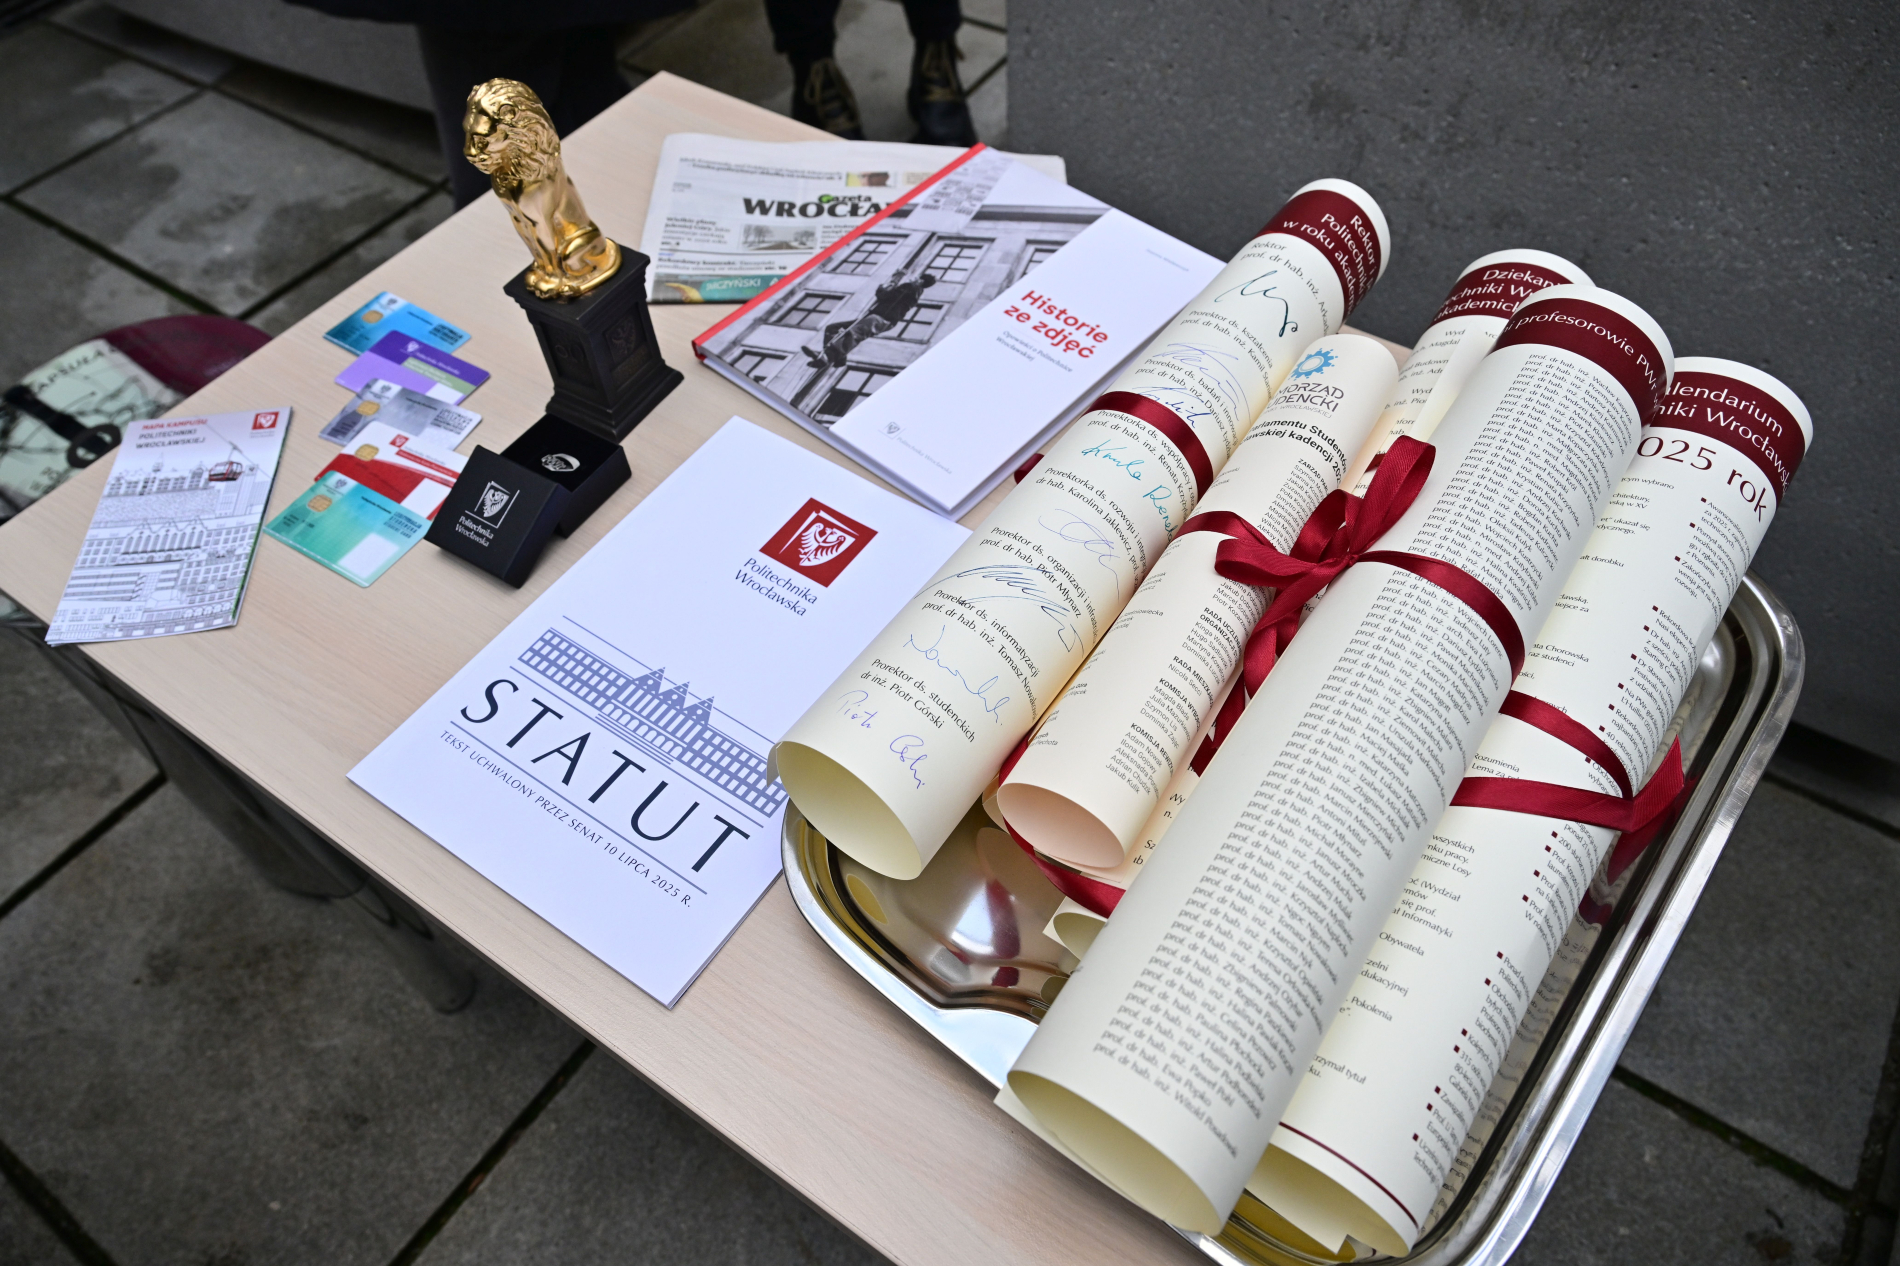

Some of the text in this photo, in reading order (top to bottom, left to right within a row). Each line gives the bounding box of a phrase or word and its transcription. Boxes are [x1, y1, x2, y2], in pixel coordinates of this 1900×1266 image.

[742, 197, 894, 218] WROCŁA
[817, 193, 872, 204] Gazeta
[1252, 241, 1287, 252] Rektor
[1283, 220, 1336, 250] w roku
[1350, 214, 1375, 265] Rektor
[1241, 251, 1265, 261] prof.
[1268, 252, 1283, 263] dr
[1283, 257, 1305, 280] hab.
[1305, 278, 1319, 300] inż.
[1482, 269, 1562, 288] Dziekan
[1021, 290, 1109, 343] Historie
[1003, 305, 1096, 359] ze zdjęć
[1180, 317, 1263, 372] prof. dr hab. inż. Kamil
[1228, 317, 1240, 329] ds.
[1241, 326, 1274, 369] kształcenia
[1515, 310, 1658, 392] profesorowie PWr
[1529, 352, 1548, 361] prof.
[1559, 359, 1577, 371] hab.
[1184, 368, 1197, 381] ds.
[1197, 377, 1222, 403] badań
[1665, 381, 1784, 438] lendarium
[138, 428, 198, 440] POLITECHNIKI
[166, 418, 208, 429] KAMPUSU
[135, 437, 206, 449] WROCŁAWSKIEJ
[1087, 420, 1179, 485] prof. dr hab. inż. Renata
[1288, 430, 1333, 464] kadencji
[1147, 429, 1159, 441] ds.
[1160, 440, 1192, 486] współpracy
[1035, 475, 1047, 486] dr
[1047, 477, 1066, 492] hab.
[1068, 486, 1104, 515] Karolina
[1641, 478, 1675, 490] wybrano
[1726, 468, 1768, 523] rok
[1095, 488, 1107, 502] ds.
[1108, 500, 1136, 535] rozwoju
[455, 523, 490, 548] Wrocławska
[458, 515, 494, 540] Politechnika
[1032, 544, 1044, 557] ds.
[1047, 554, 1088, 599] organizacji
[1591, 555, 1625, 568] dorobku
[742, 556, 818, 606] Politechnika
[979, 538, 1083, 619] prof. dr hab. Piotr Młynarz
[734, 568, 808, 618] Wrocławska
[1204, 607, 1223, 625] RADA
[1387, 577, 1407, 587] prof.
[1409, 583, 1421, 591] dr
[1421, 586, 1439, 600] hab.
[1440, 596, 1455, 610] inż.
[1457, 606, 1489, 637] Wojciech
[921, 600, 1024, 680] prof. dr hab. inż. Tomasz
[1190, 627, 1208, 645] Hugo
[1452, 614, 1480, 641] Tadeusz
[975, 609, 988, 622] ds.
[990, 619, 1041, 678] informatyzacji
[1441, 632, 1469, 659] Dariusz
[1544, 643, 1590, 664] Chorowska
[1426, 659, 1452, 683] Cezary
[1541, 651, 1576, 668] studenci
[860, 670, 945, 730] dr inż. Piotr Górski
[871, 658, 976, 744] Prorektor ds. studenckich
[1159, 677, 1189, 703] KOMISJA
[1140, 707, 1169, 735] Dominika
[1144, 700, 1170, 725] Szymon
[1124, 731, 1145, 750] Adam
[1130, 722, 1160, 751] KOMISJA
[460, 678, 751, 873] STATUT
[1110, 754, 1133, 774] Adrian
[1105, 763, 1141, 794] Jakub Kulik
[440, 729, 693, 908] TEKST UCHWALONY PRZEZ SENAT 10 LIPCA 2025 R.
[1432, 834, 1475, 854] wszystkich
[1444, 850, 1470, 864] pracy.
[1452, 863, 1472, 878] Losy
[1420, 880, 1461, 902] (Wydział
[1401, 898, 1437, 918] się prof.
[1402, 909, 1454, 939] Informatyki
[1379, 931, 1425, 957] Obywatela
[1351, 996, 1393, 1022] Pokolenia
[1345, 1068, 1367, 1085] tytuł
